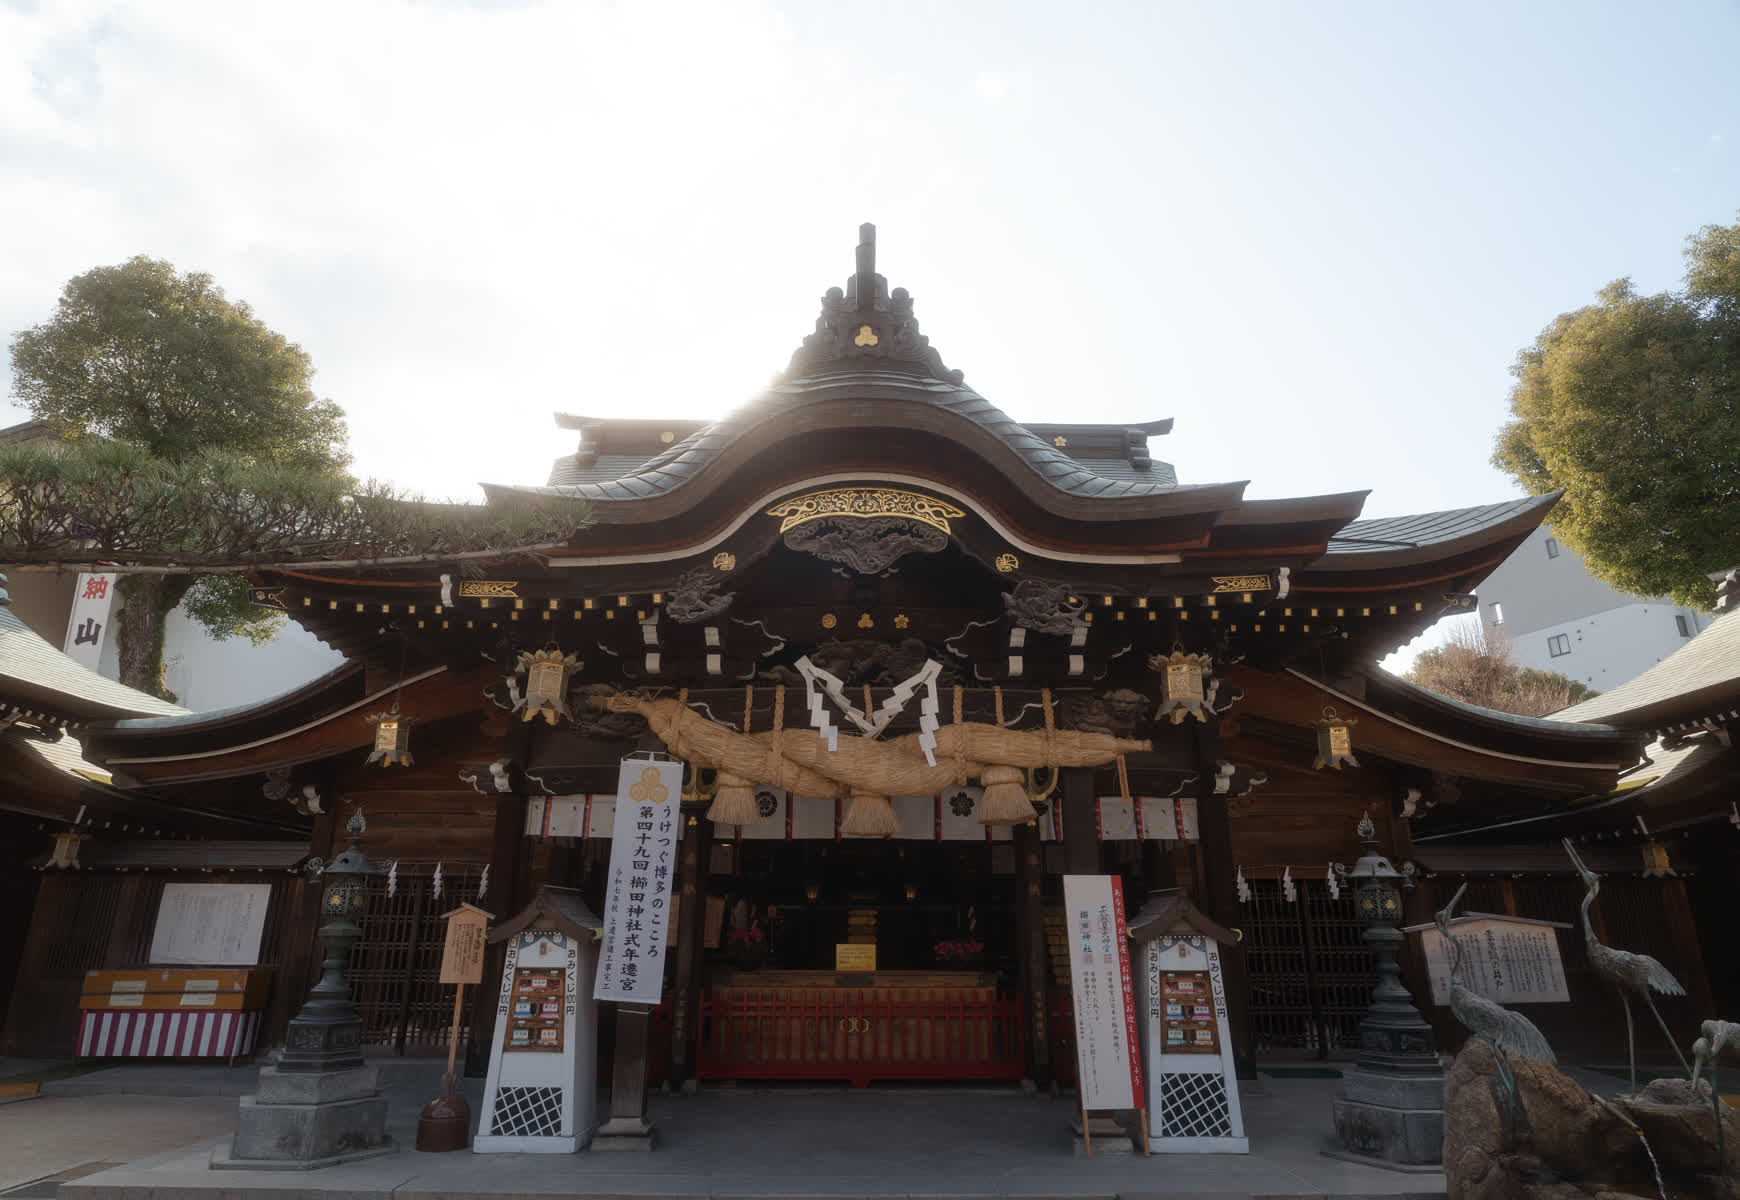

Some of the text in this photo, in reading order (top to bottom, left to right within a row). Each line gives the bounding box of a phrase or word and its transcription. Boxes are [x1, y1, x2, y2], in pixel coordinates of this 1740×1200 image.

[74, 576, 109, 646] 納 山
[620, 806, 654, 991] 第四十九回 櫛田神社式年遷宮
[647, 805, 673, 958] うけつぐ博多のこころ
[498, 949, 516, 1016] おみくじ100円
[566, 949, 577, 1016] おみくじ100円
[1149, 952, 1160, 1019] おみくじ100円
[1209, 951, 1225, 1018] おみくじ100円
